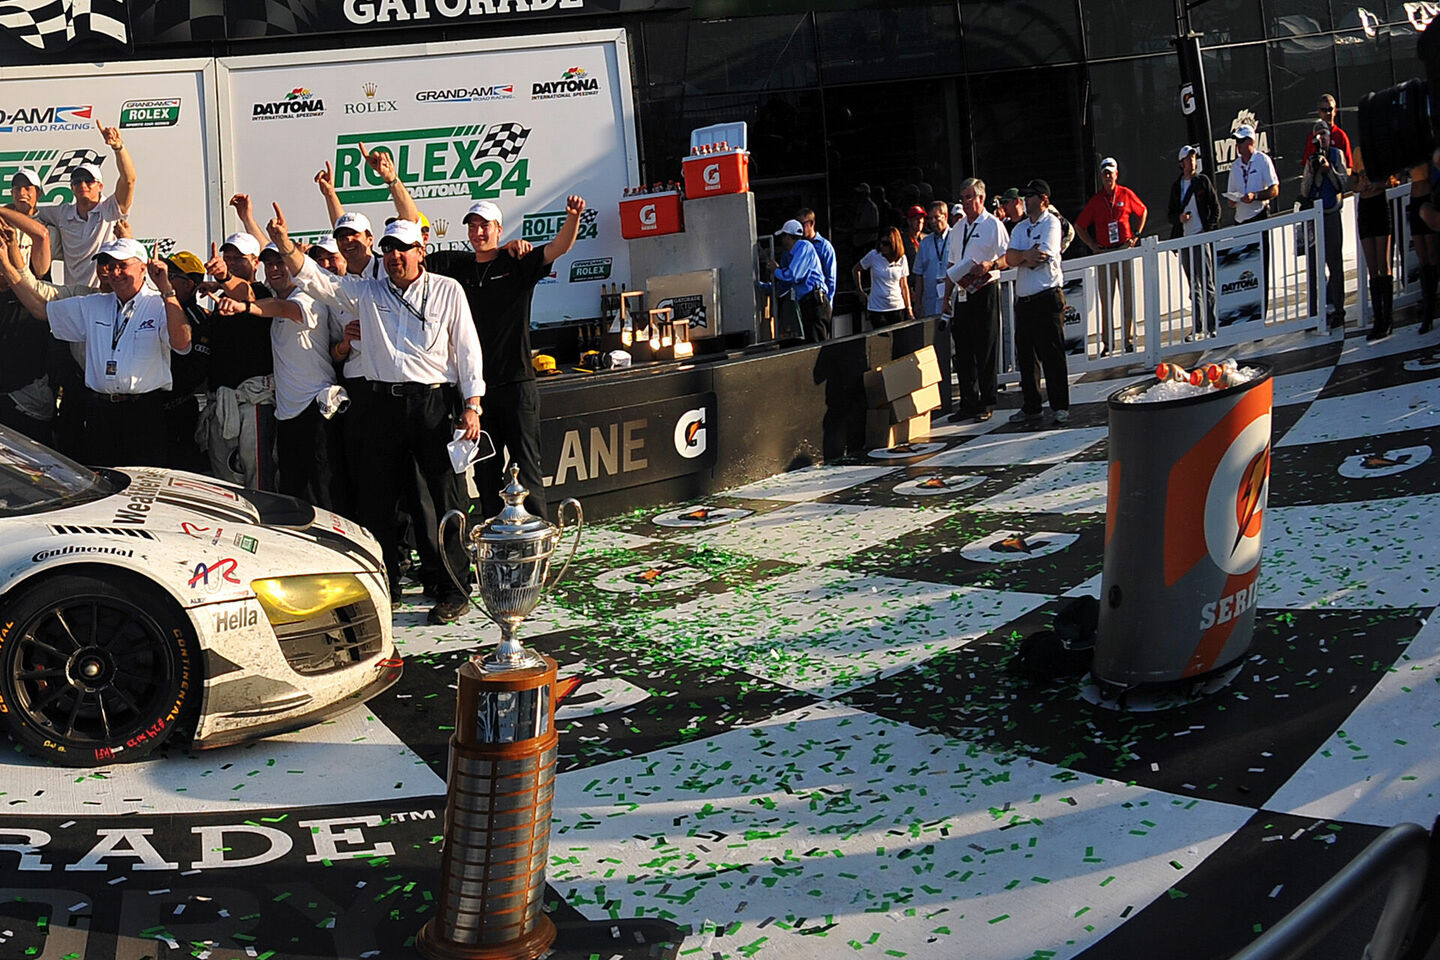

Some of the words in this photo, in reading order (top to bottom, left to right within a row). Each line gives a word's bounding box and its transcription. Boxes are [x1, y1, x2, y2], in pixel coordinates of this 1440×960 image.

[531, 78, 599, 96] DAYTONA
[129, 108, 170, 120] ROLEX
[252, 99, 324, 116] DAYTONA
[344, 100, 398, 115] ROLEX
[16, 124, 47, 134] ROAD
[49, 121, 92, 132] RACING
[473, 158, 531, 202] 24
[576, 265, 605, 276] ROLEX
[1221, 276, 1259, 293] DAYTONA
[540, 418, 648, 487] ANE
[31, 544, 135, 563] Continental
[216, 604, 258, 633] Hella
[165, 627, 191, 722] CONTINENTAL
